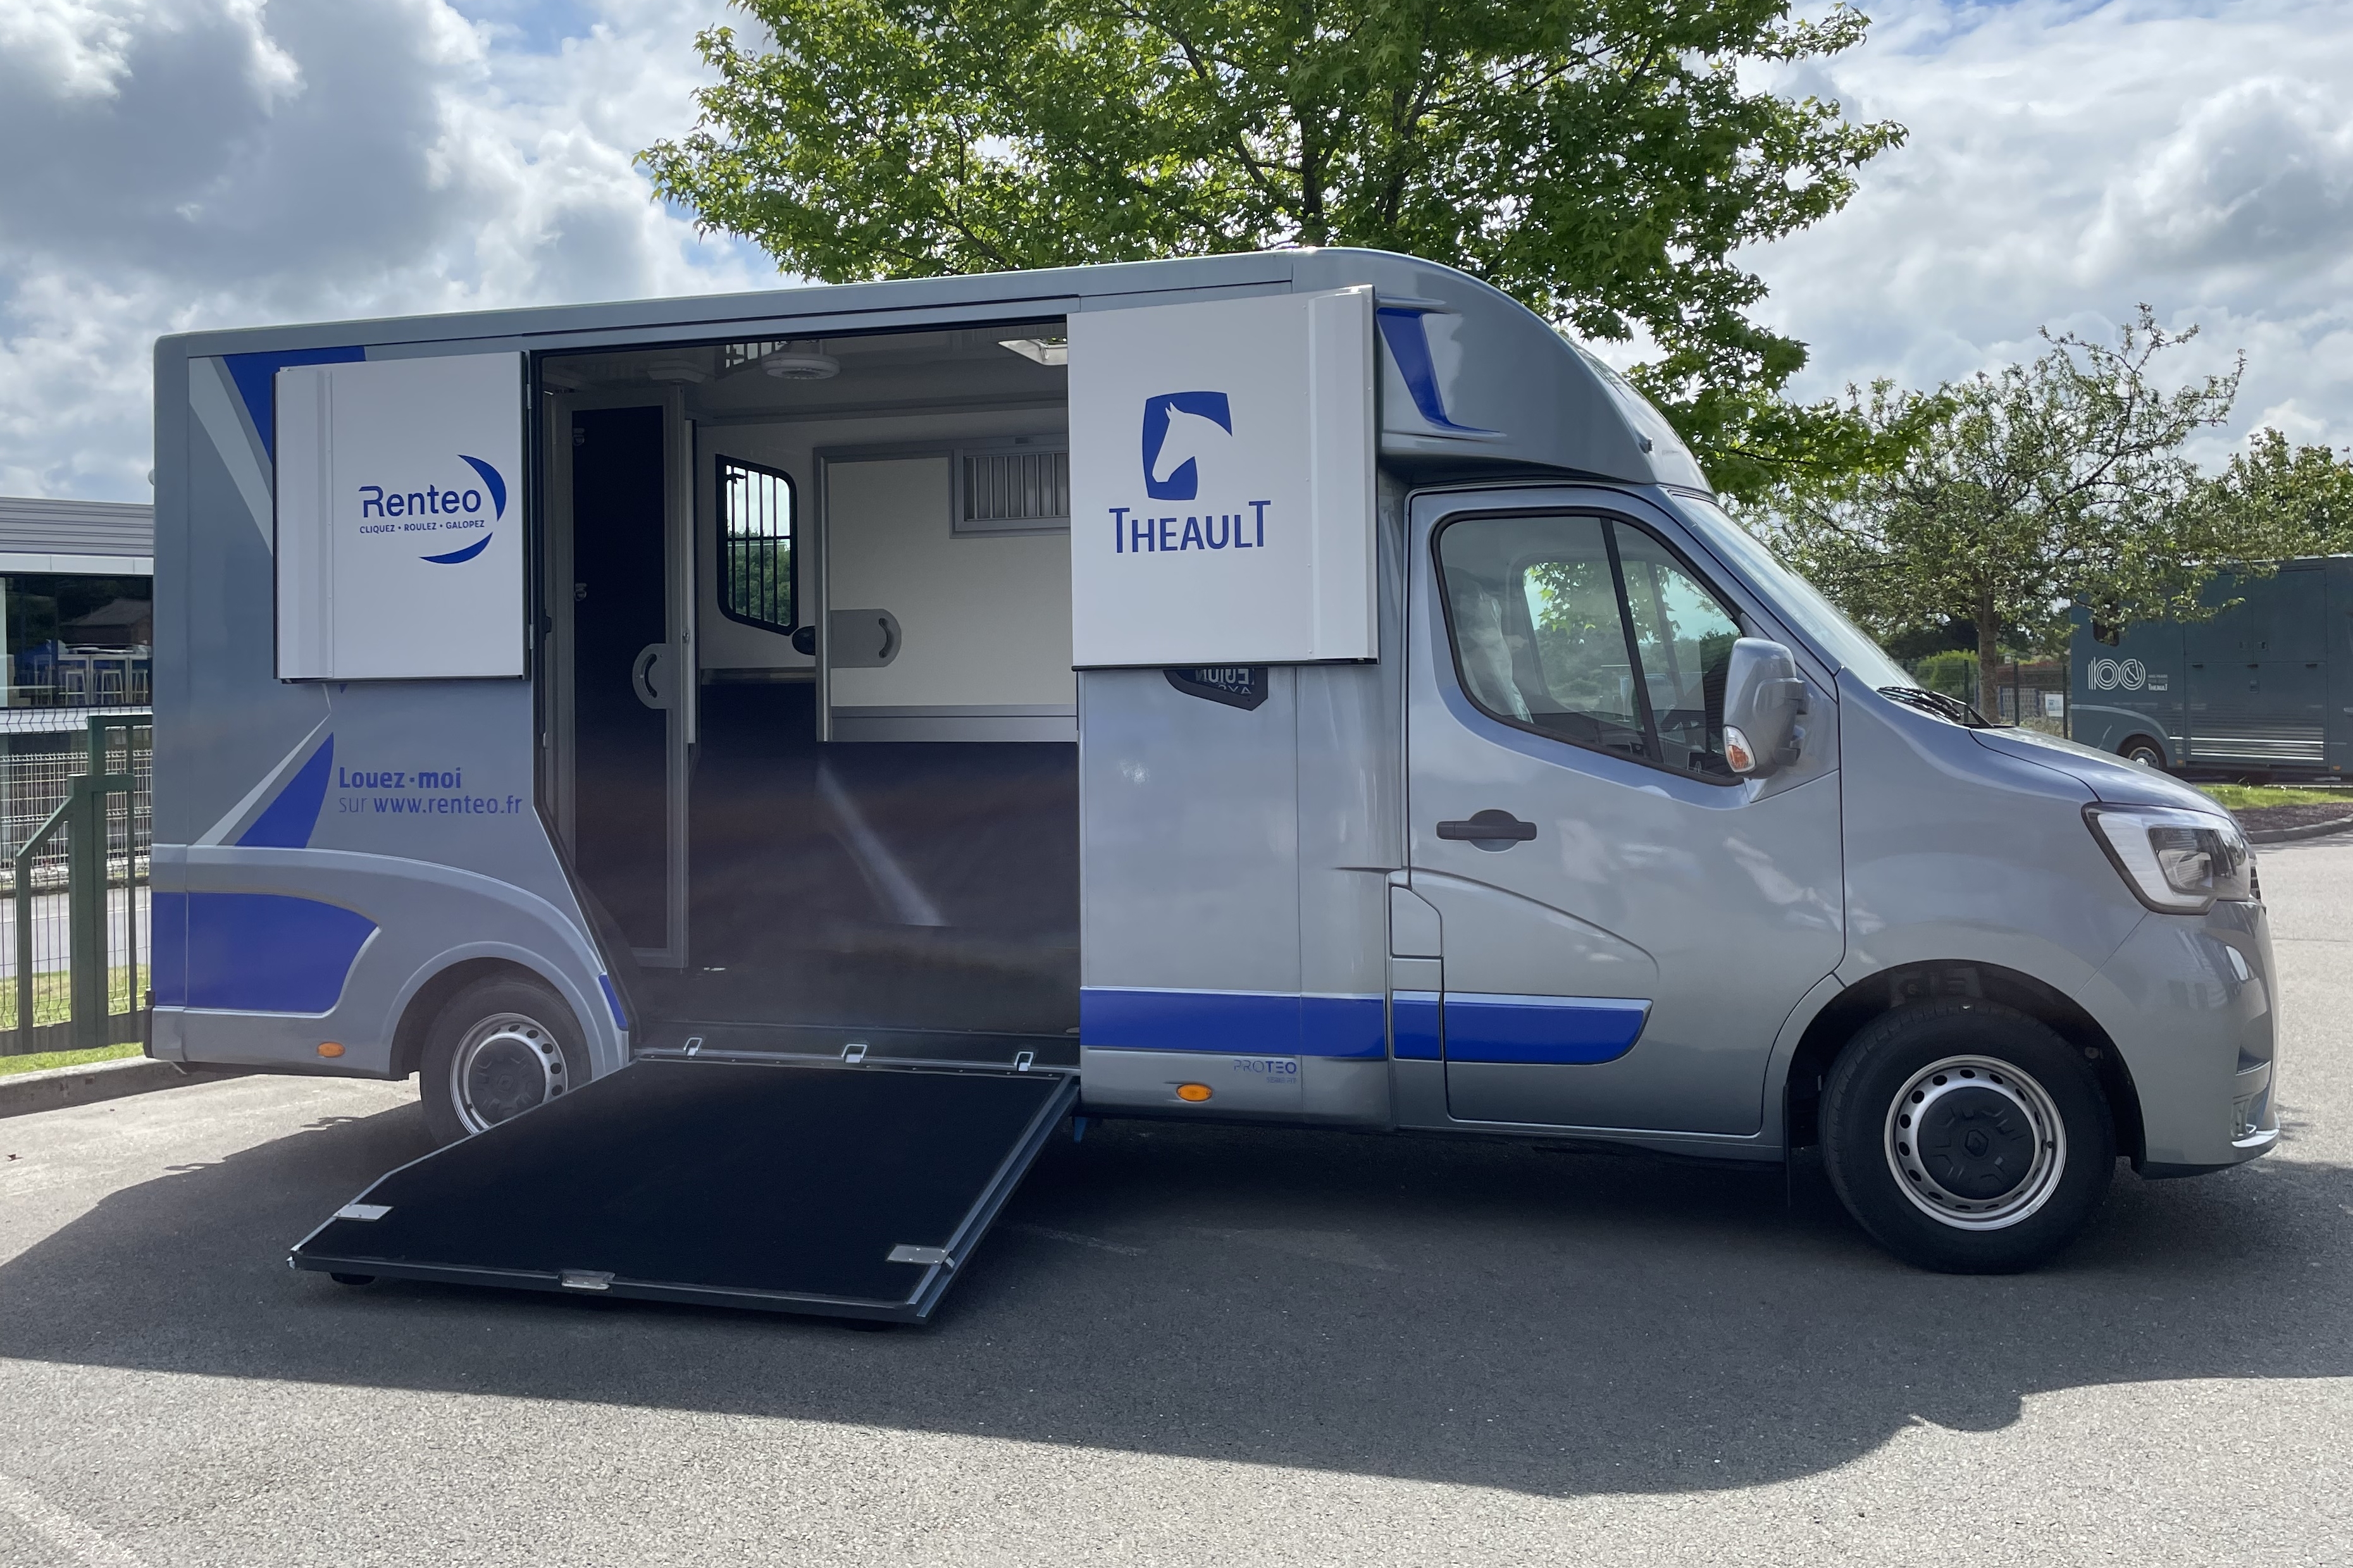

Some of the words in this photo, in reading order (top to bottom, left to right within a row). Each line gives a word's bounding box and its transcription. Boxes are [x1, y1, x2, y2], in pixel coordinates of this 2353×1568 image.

[358, 484, 481, 518] Renteo
[359, 524, 395, 534] CLIQUEZ
[404, 522, 437, 531] ROULEZ
[445, 520, 485, 529] GALOPEZ
[1108, 500, 1271, 553] THEAULT
[338, 798, 368, 813] sur
[374, 795, 523, 814] www.renteo.fr
[1234, 1059, 1297, 1074] PROTEO
